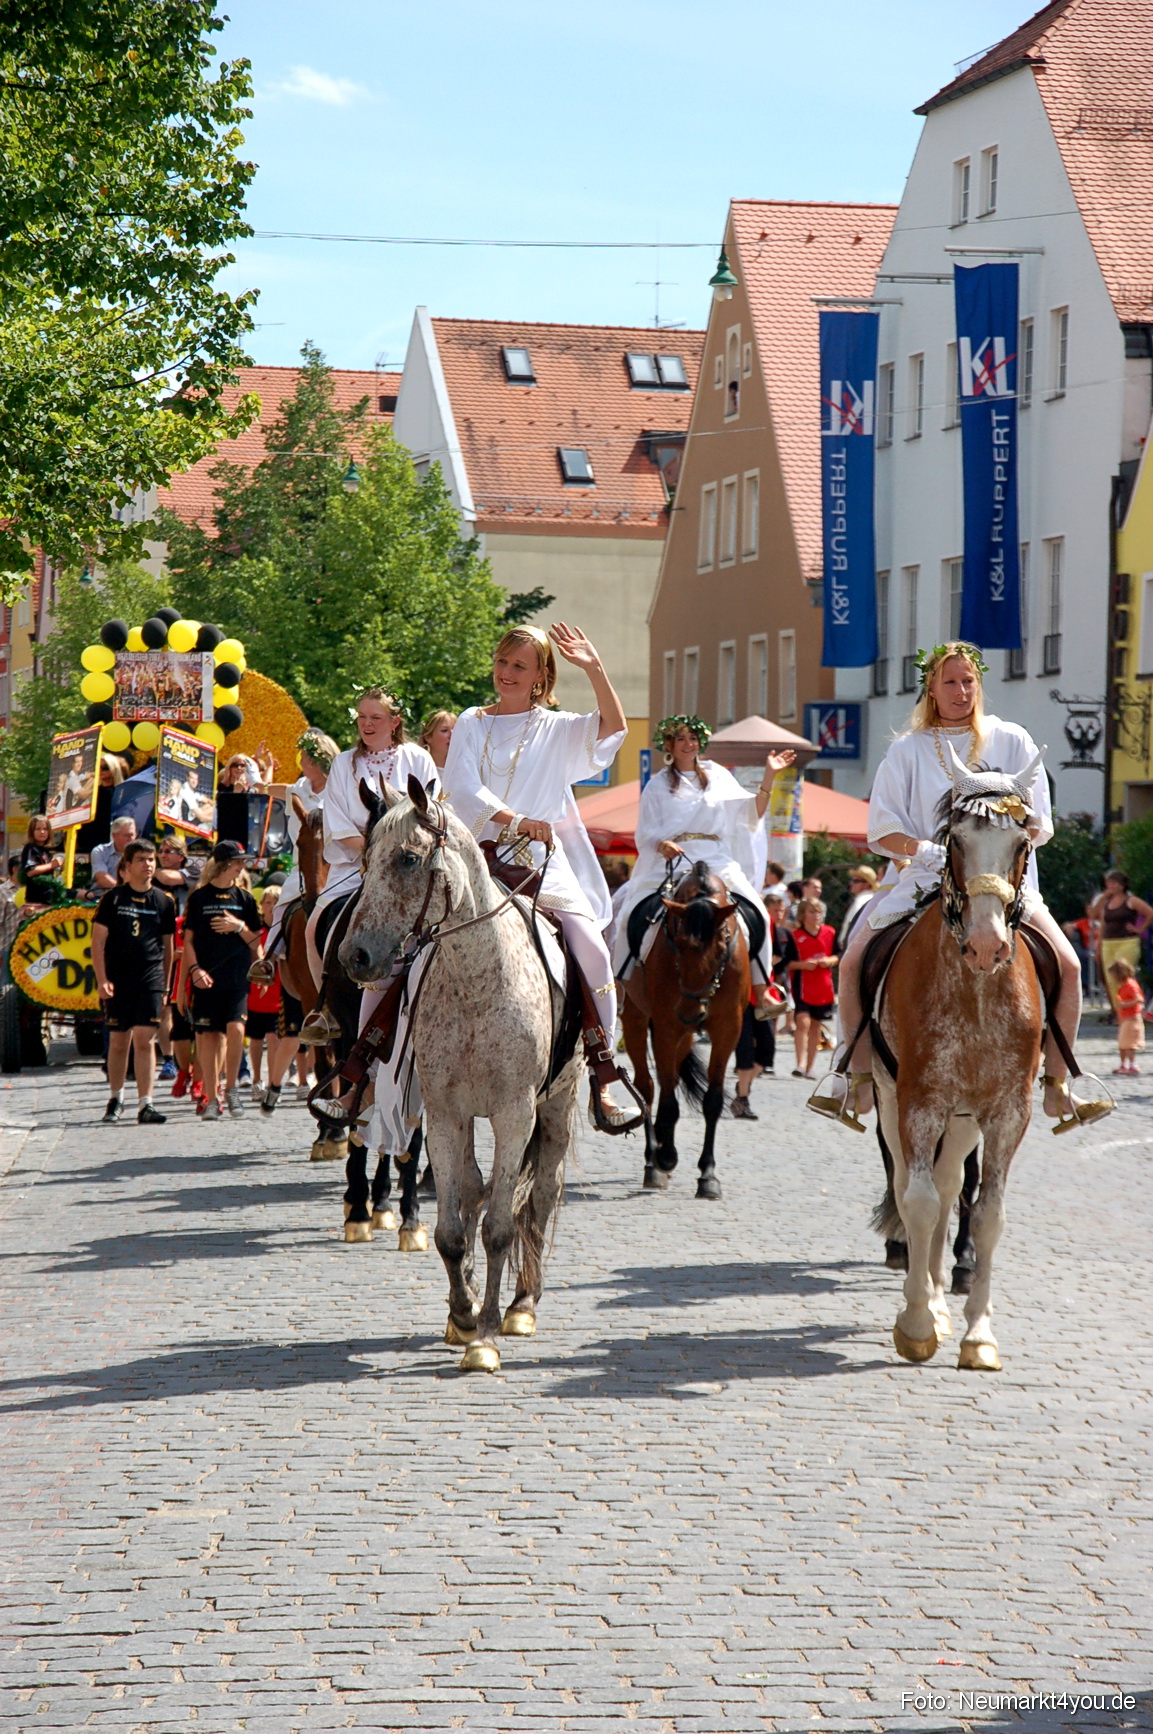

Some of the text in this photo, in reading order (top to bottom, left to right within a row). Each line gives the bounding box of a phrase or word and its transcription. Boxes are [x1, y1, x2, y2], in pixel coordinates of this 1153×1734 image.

[990, 409, 1010, 601] K&L RUPPERT
[53, 738, 85, 756] HAND
[163, 737, 200, 758] HAND
[132, 920, 140, 937] 3
[18, 918, 93, 964] HAND
